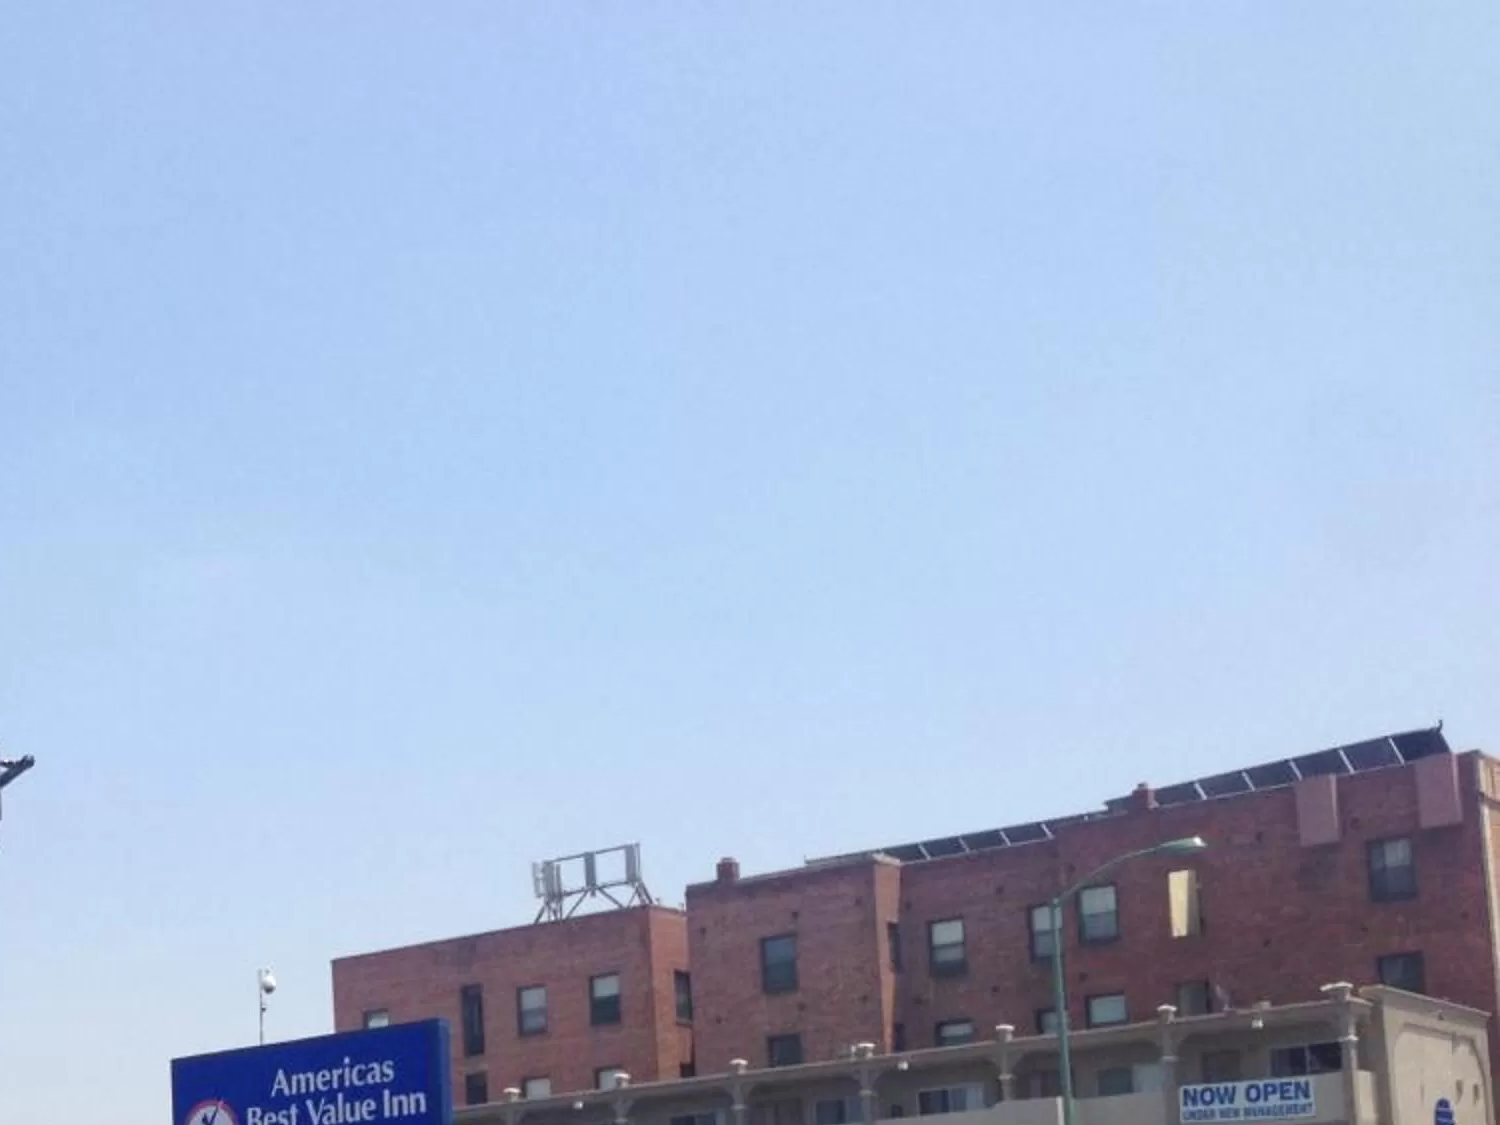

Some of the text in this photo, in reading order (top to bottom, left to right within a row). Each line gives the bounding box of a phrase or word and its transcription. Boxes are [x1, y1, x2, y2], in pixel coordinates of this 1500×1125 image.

[271, 1055, 395, 1097] Americas
[383, 1088, 427, 1118] Inn
[1182, 1080, 1311, 1107] NOW OPEN
